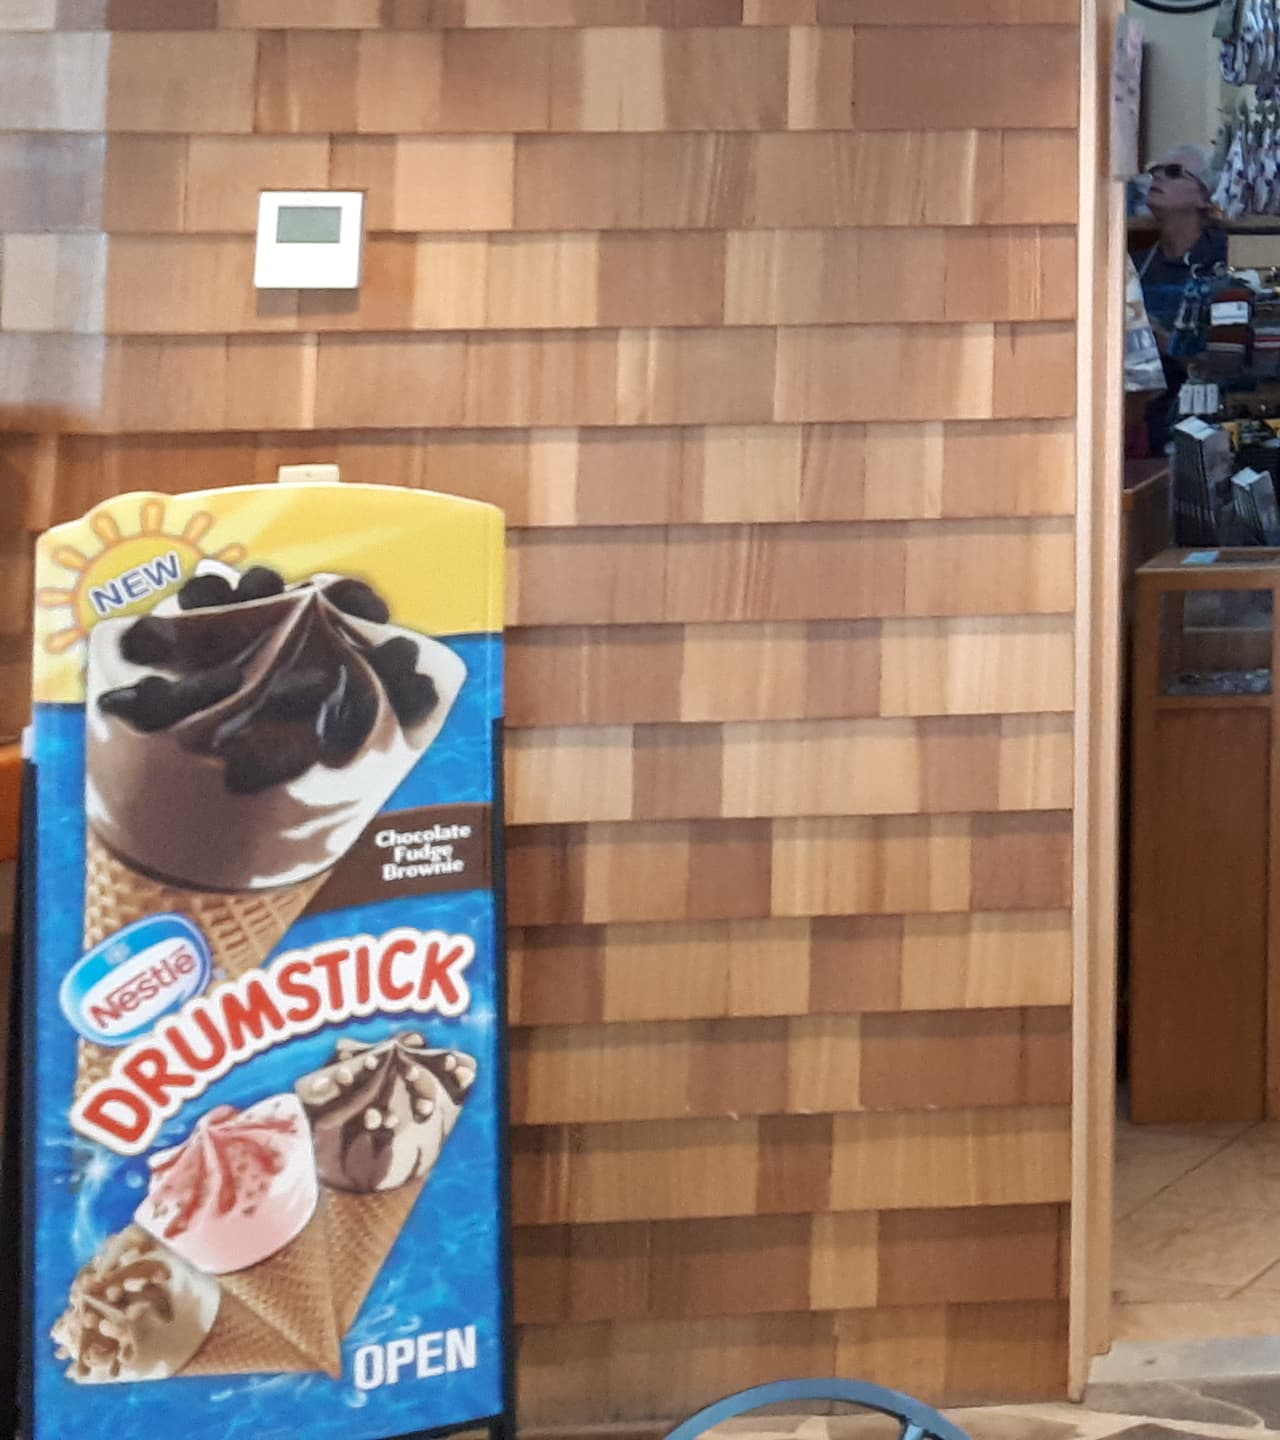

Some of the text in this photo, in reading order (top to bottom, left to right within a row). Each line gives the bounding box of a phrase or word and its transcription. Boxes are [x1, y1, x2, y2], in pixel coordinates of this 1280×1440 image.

[90, 553, 180, 614] NEW
[375, 824, 472, 848] Chocolate
[393, 843, 454, 865] Fudge
[382, 859, 465, 881] Brownie
[82, 939, 464, 1143] DRUMSTICK
[354, 1324, 478, 1391] OPEN
